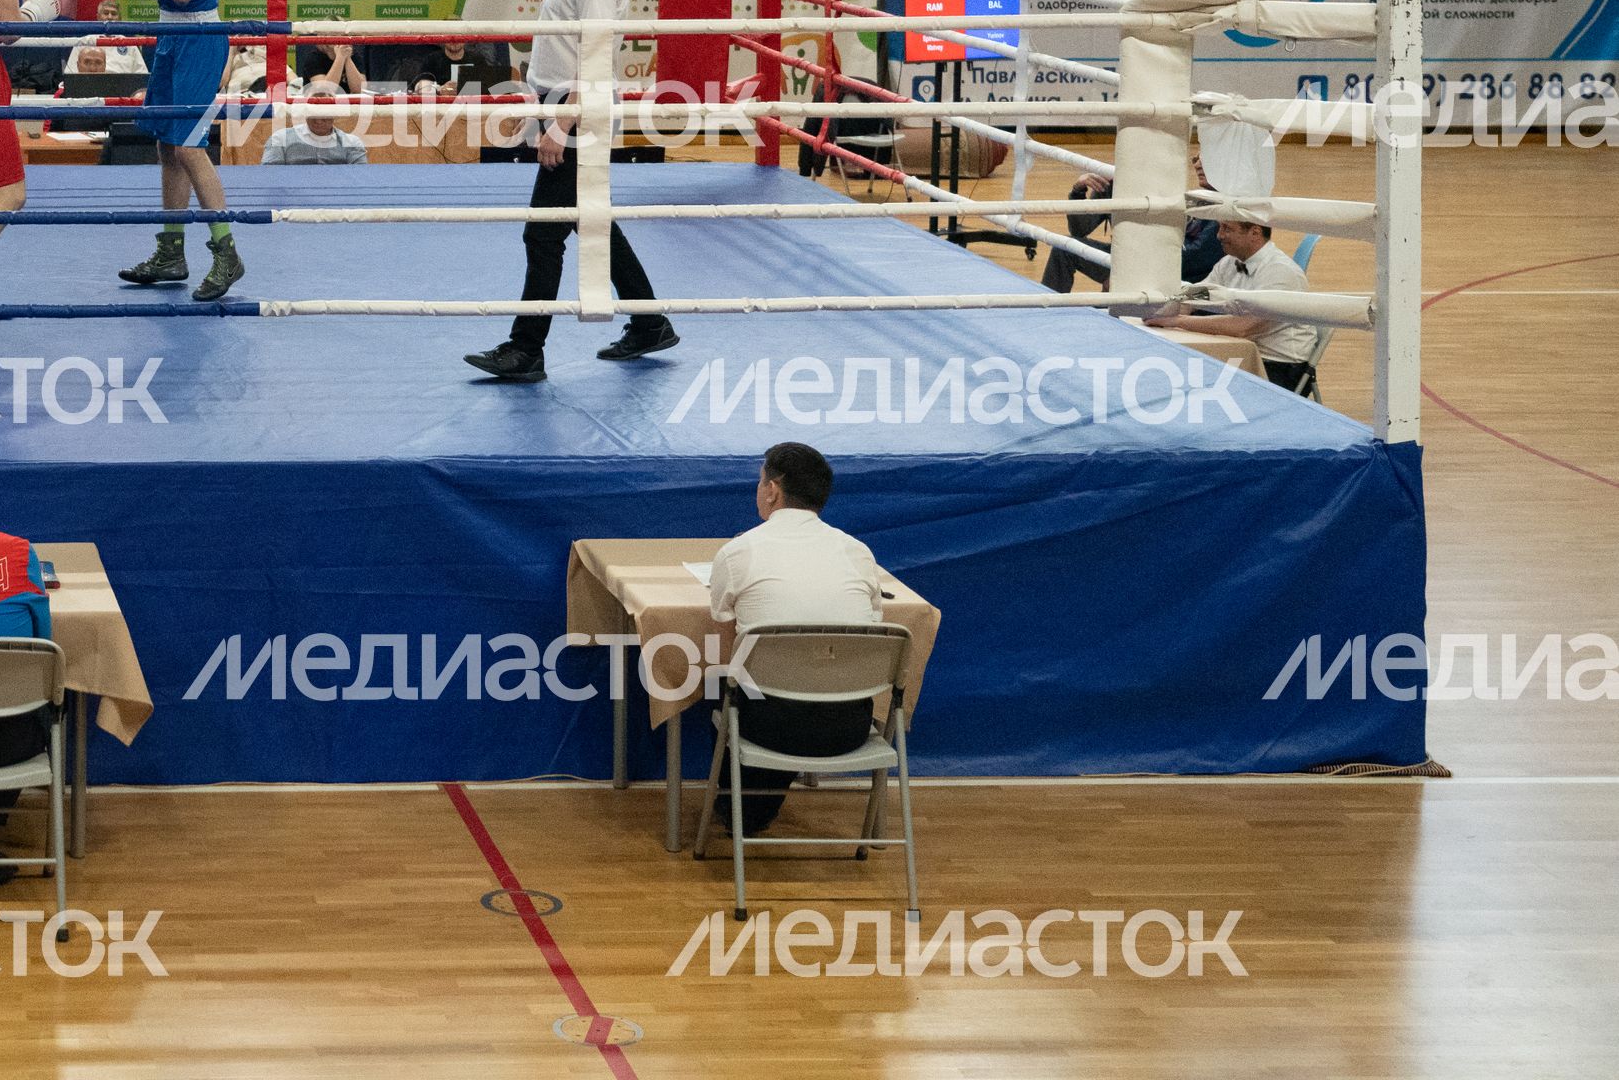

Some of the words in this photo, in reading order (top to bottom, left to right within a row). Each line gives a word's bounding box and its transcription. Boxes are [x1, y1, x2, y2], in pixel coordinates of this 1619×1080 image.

[302, 6, 345, 16] УРОЛОГИЯ
[382, 6, 423, 16] АНАЛИЗЫ
[1444, 10, 1514, 19] сложности
[1528, 73, 1564, 99] 88
[1580, 73, 1617, 100] 82
